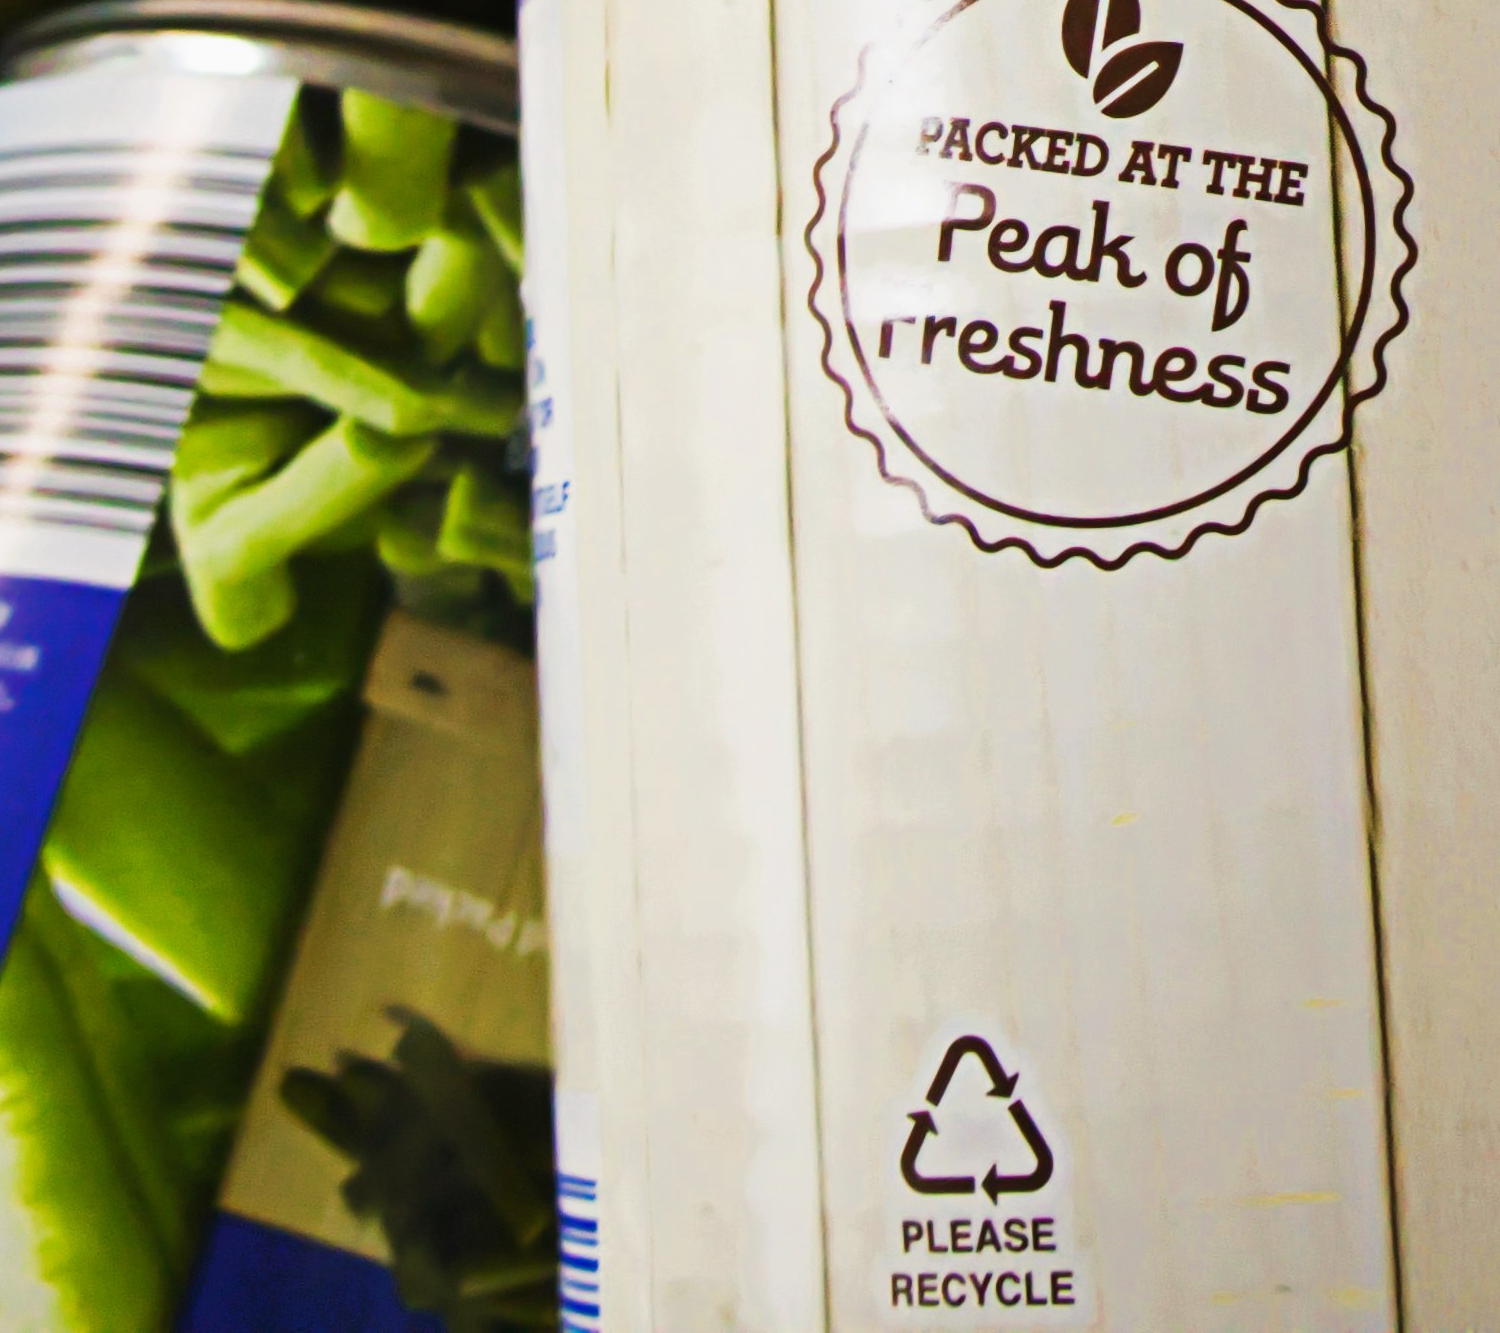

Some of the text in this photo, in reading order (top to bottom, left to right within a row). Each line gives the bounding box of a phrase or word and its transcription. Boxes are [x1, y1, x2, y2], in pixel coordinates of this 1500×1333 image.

[917, 117, 1310, 208] PACKED AT THE
[935, 180, 1252, 333] Peak of
[876, 299, 1293, 417] Freshness
[901, 1216, 1058, 1255] PLEASE
[888, 1270, 1077, 1310] RECYCLE
